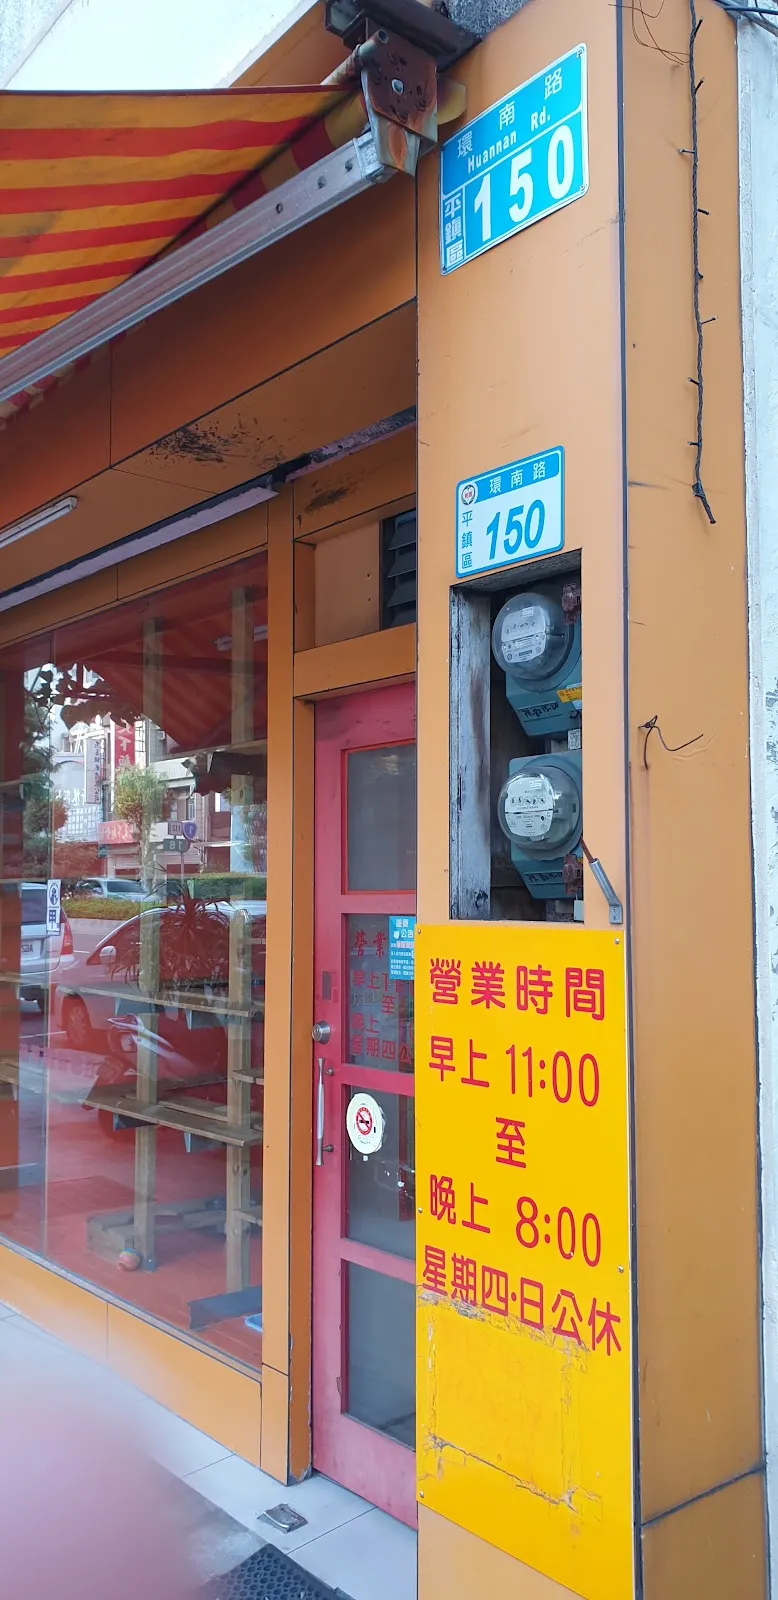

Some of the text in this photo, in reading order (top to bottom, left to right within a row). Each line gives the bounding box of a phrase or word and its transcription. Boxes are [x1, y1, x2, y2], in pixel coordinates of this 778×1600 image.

[457, 67, 563, 159] 環南路
[467, 105, 551, 174] Huannan Rd.
[474, 124, 575, 243] 150
[445, 192, 464, 267] 平鎮區
[489, 461, 546, 494] 環南路
[462, 510, 473, 569] 平鎮區
[486, 499, 545, 561] 150
[382, 995, 396, 1014] 至
[430, 957, 605, 1021] 營業時間
[428, 1035, 600, 1107] 早上 11:00
[495, 1116, 527, 1169] 至
[429, 1174, 601, 1267] 晚上 8:00
